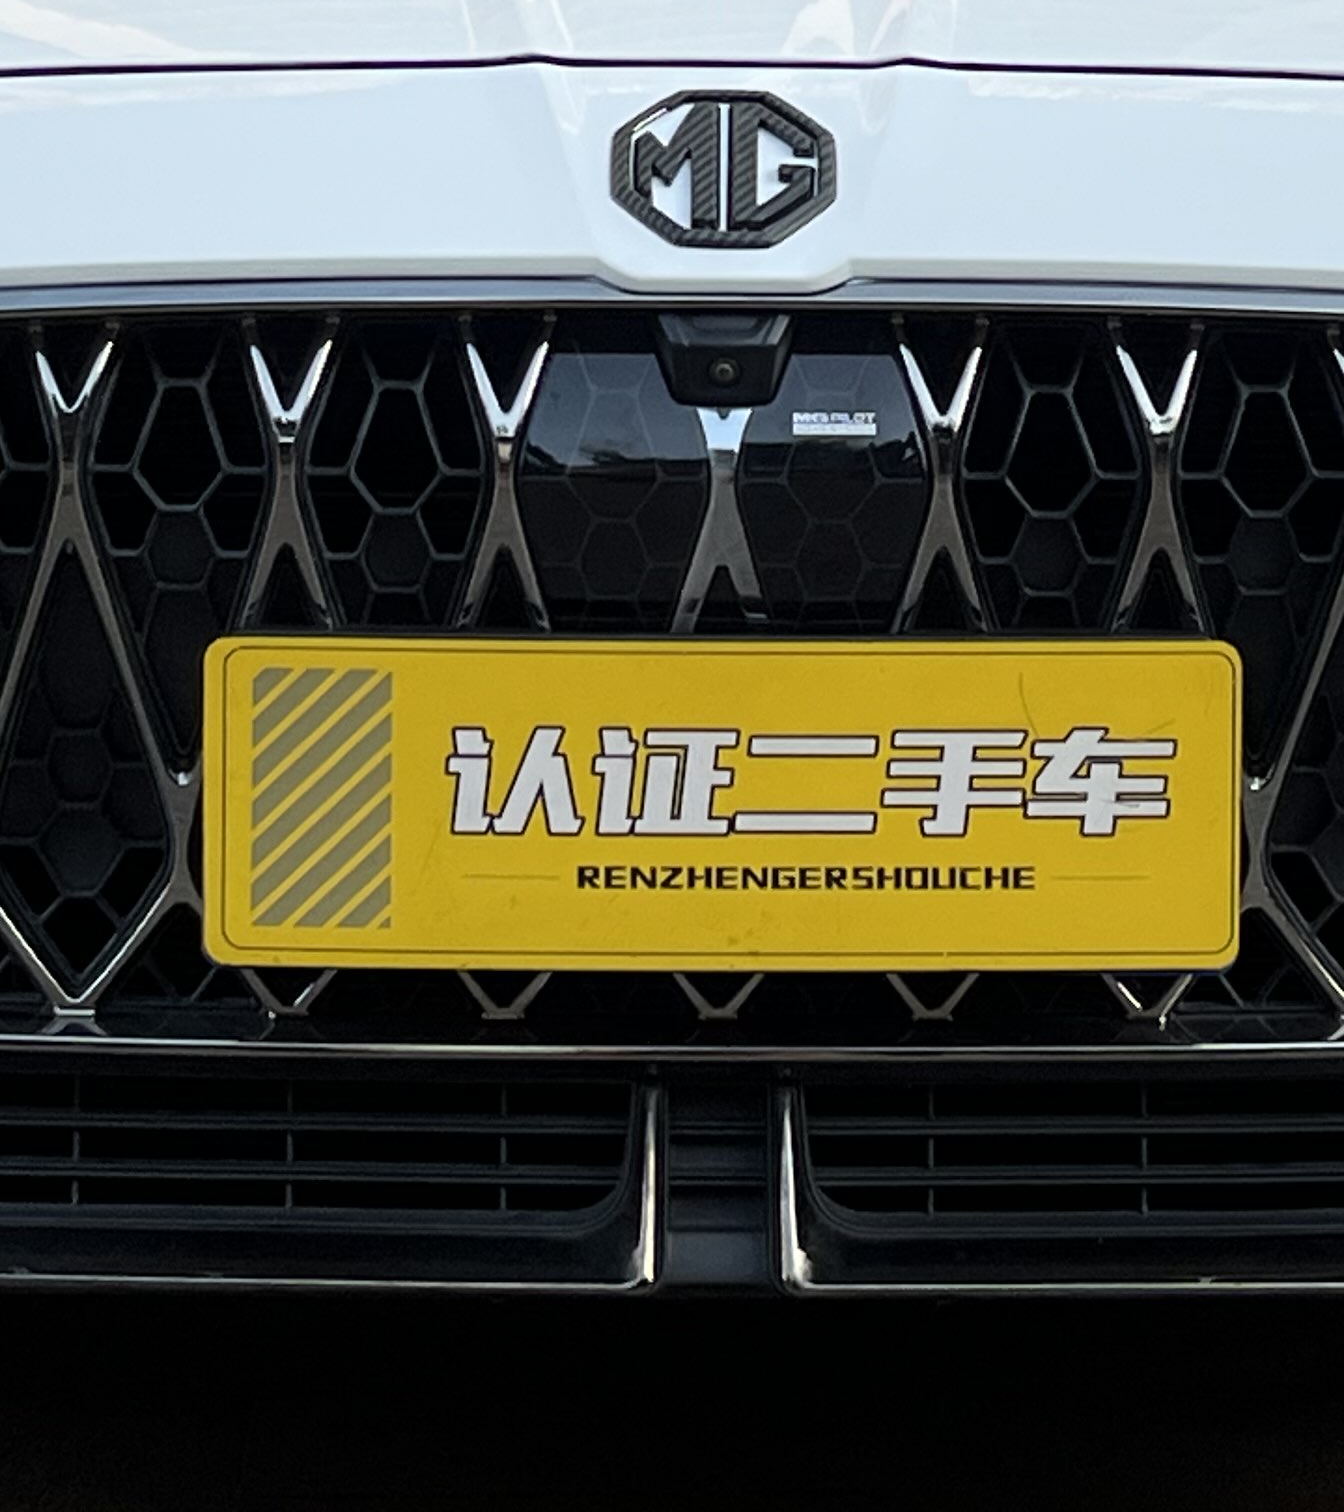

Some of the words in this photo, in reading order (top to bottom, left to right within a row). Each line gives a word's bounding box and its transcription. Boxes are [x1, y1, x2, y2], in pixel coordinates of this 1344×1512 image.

[628, 97, 822, 235] MG
[444, 725, 1178, 838] 认证二手车
[576, 865, 1036, 890] RENZHENGERSHOUCHE
